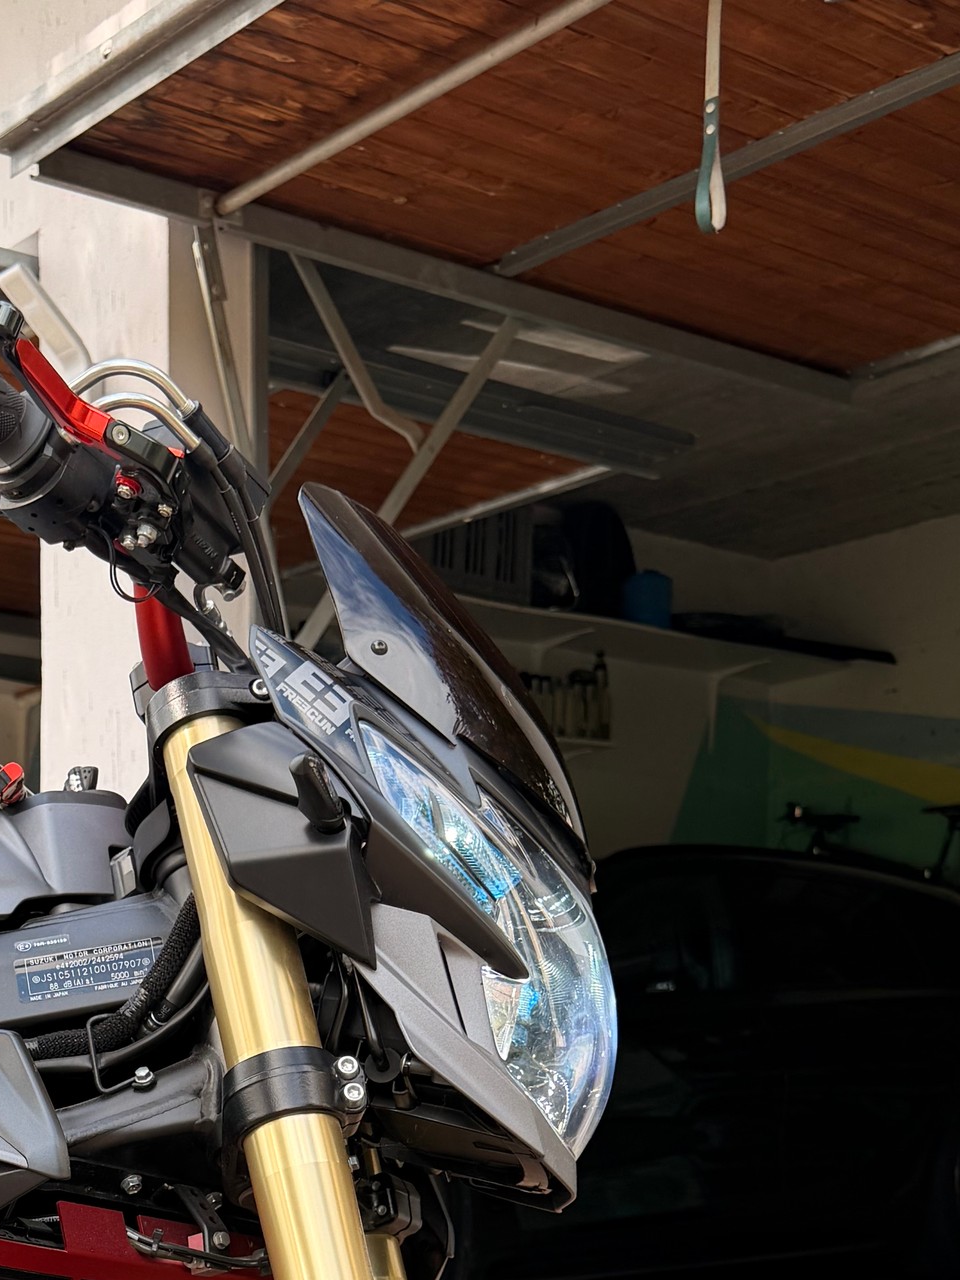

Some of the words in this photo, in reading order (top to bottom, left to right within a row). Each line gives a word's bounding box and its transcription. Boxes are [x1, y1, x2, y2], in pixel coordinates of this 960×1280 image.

[29, 956, 58, 966] SUZUKI
[63, 950, 89, 960] MOTOR
[93, 940, 148, 955] CORPORATION
[49, 982, 59, 990] 88
[111, 971, 129, 980] 5000
